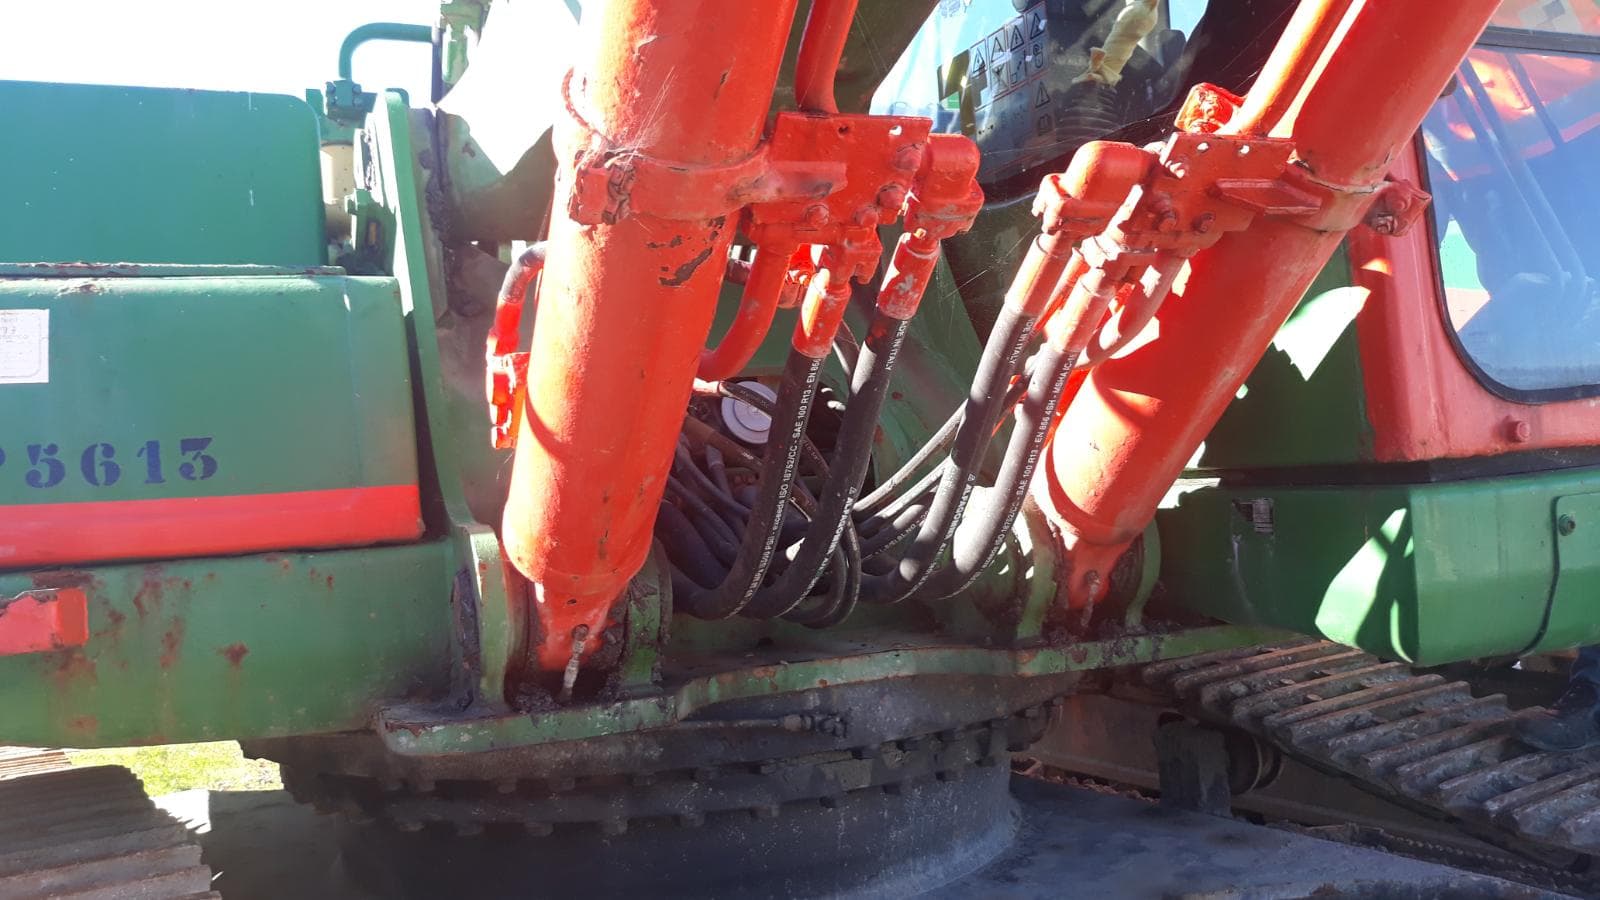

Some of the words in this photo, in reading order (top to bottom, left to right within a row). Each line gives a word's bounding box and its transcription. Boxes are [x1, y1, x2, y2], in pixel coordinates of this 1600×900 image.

[885, 348, 898, 370] ITALY
[1008, 342, 1024, 364] ITALY
[806, 372, 817, 383] EN
[801, 389, 812, 404] R13
[797, 405, 807, 419] 100
[792, 420, 804, 439] SAE
[1016, 479, 1028, 496] SAE
[1023, 463, 1033, 477] 100
[1028, 448, 1039, 464] R13
[1034, 431, 1044, 443] EN
[779, 483, 789, 499] ISO
